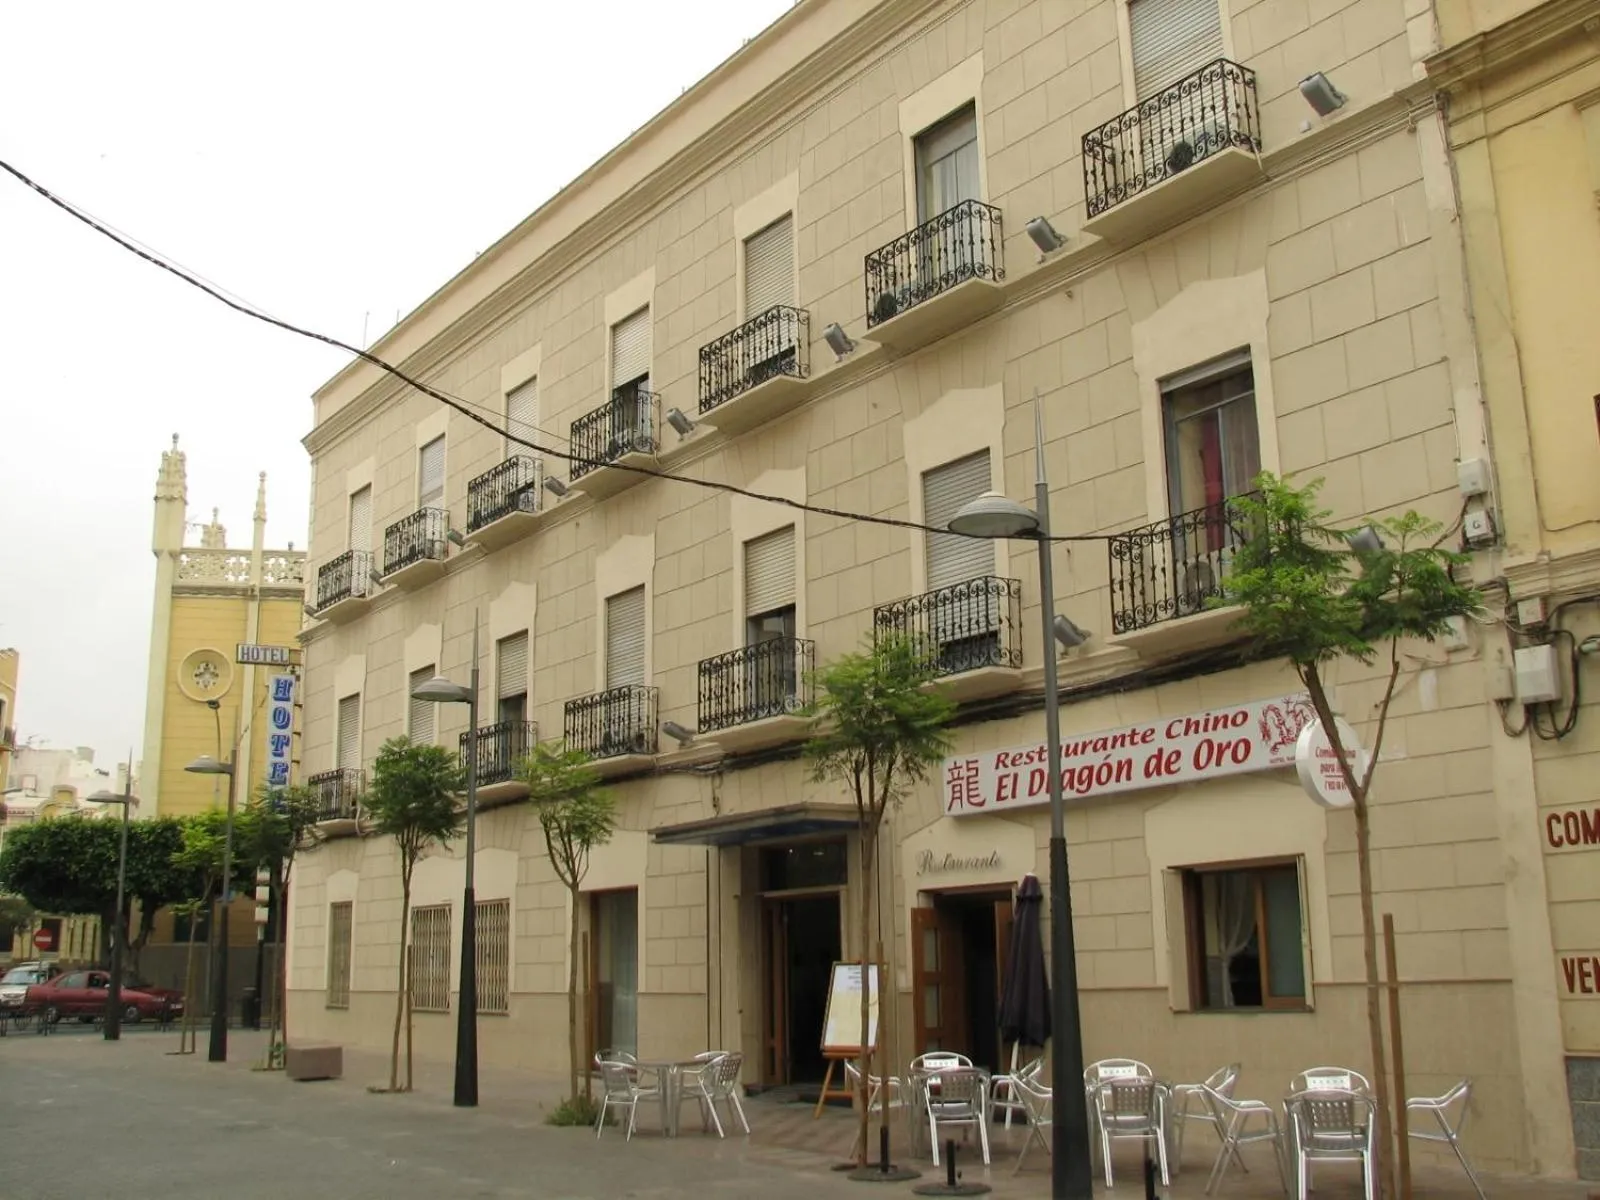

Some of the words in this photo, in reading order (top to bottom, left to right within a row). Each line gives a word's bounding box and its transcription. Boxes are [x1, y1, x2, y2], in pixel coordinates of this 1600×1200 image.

[241, 646, 289, 663] HOTEL
[994, 727, 1156, 770] Resturante
[1165, 710, 1249, 740] Chino
[947, 759, 987, 812] 龍
[996, 772, 1019, 802] El
[1144, 747, 1182, 779] de
[1193, 738, 1251, 771] Oro
